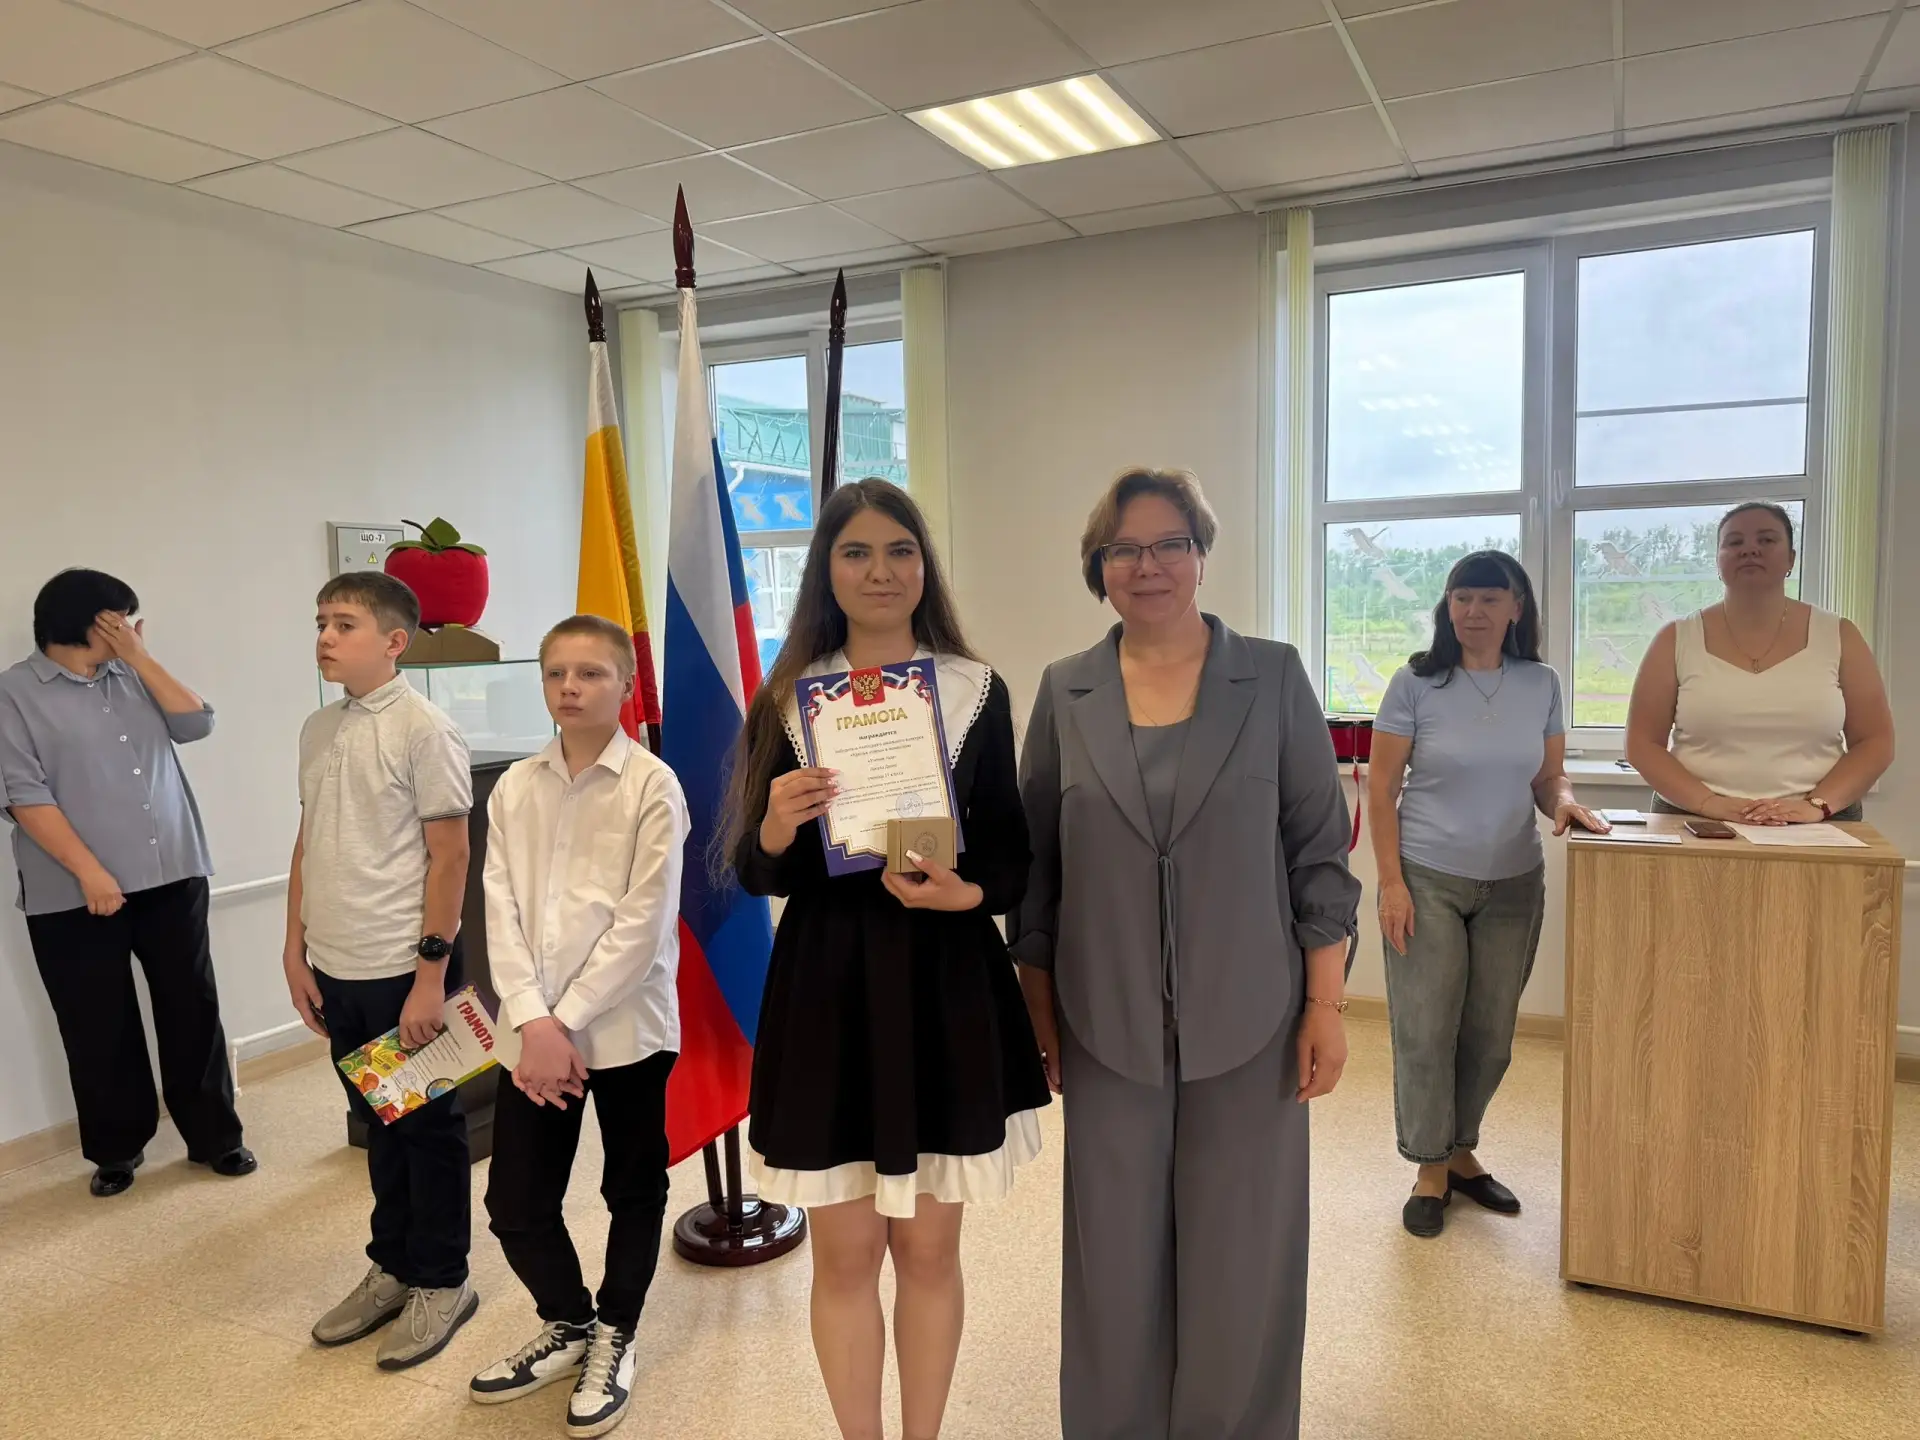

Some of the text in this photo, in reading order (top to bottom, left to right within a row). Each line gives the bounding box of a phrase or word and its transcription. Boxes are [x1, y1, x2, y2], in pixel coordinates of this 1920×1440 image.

[361, 533, 374, 542] ЩО
[836, 707, 908, 731] ГРАМОТА
[456, 1000, 495, 1052] ГРАМОТА
